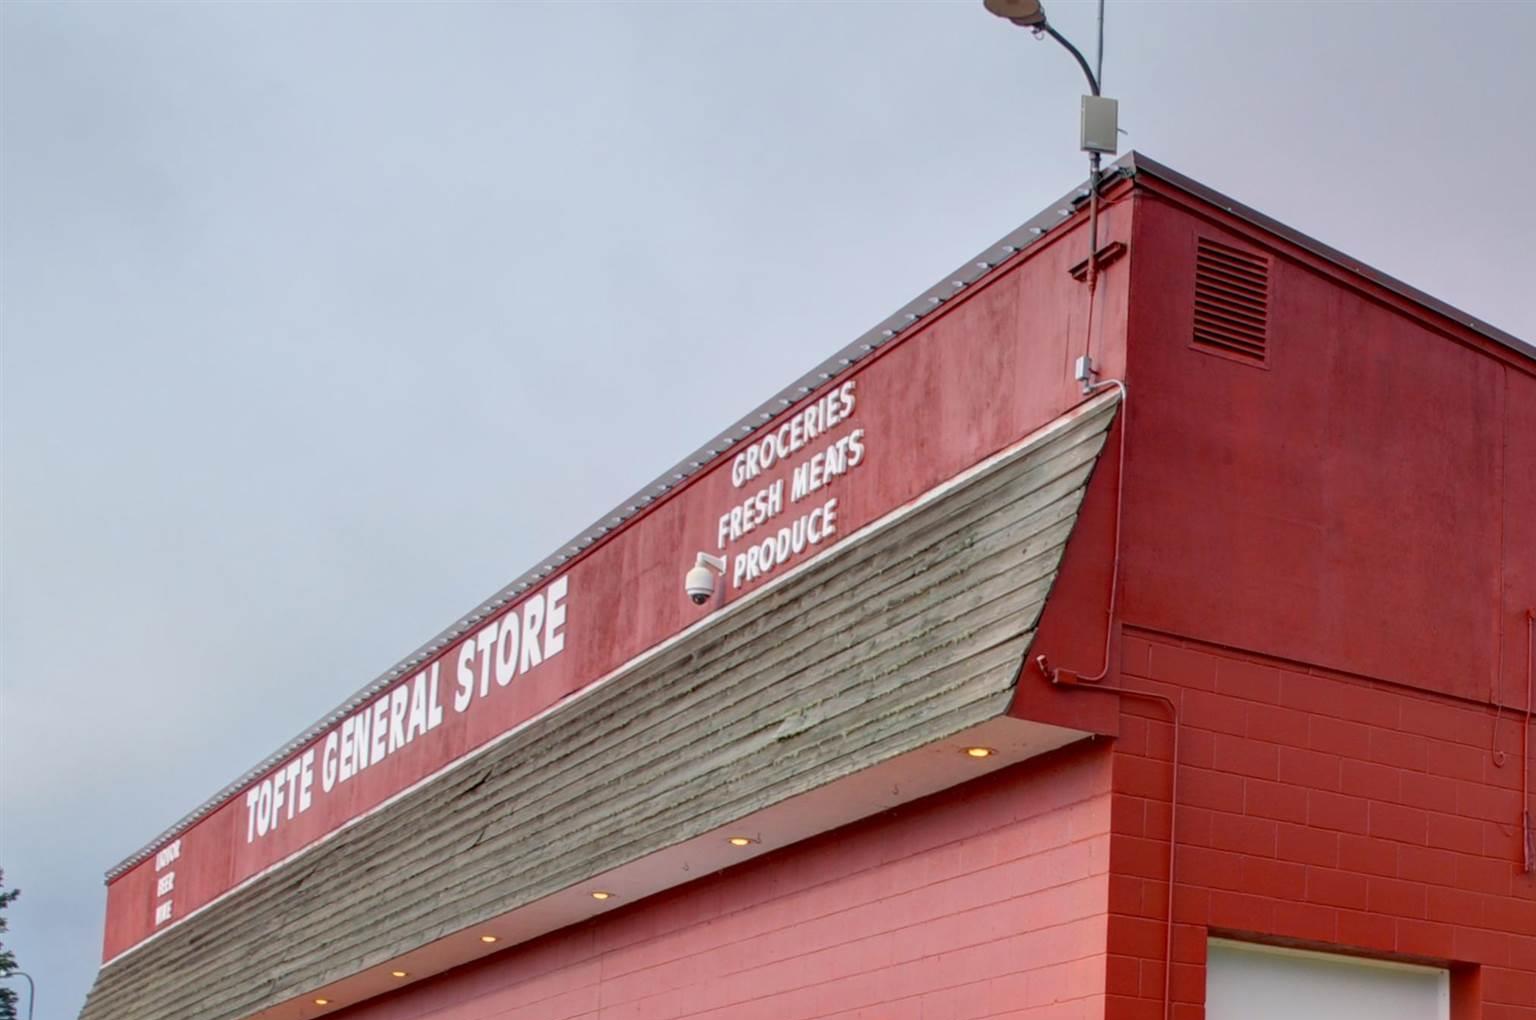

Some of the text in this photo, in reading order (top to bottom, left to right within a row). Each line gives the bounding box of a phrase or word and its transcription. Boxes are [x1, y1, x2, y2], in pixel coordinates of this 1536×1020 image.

[732, 381, 856, 488] GROCERIES
[718, 428, 865, 549] FRESH MEATS
[733, 497, 838, 588] PRODUCE
[246, 575, 568, 844] TOFTE GENERAL STORE
[157, 872, 175, 897] BEER
